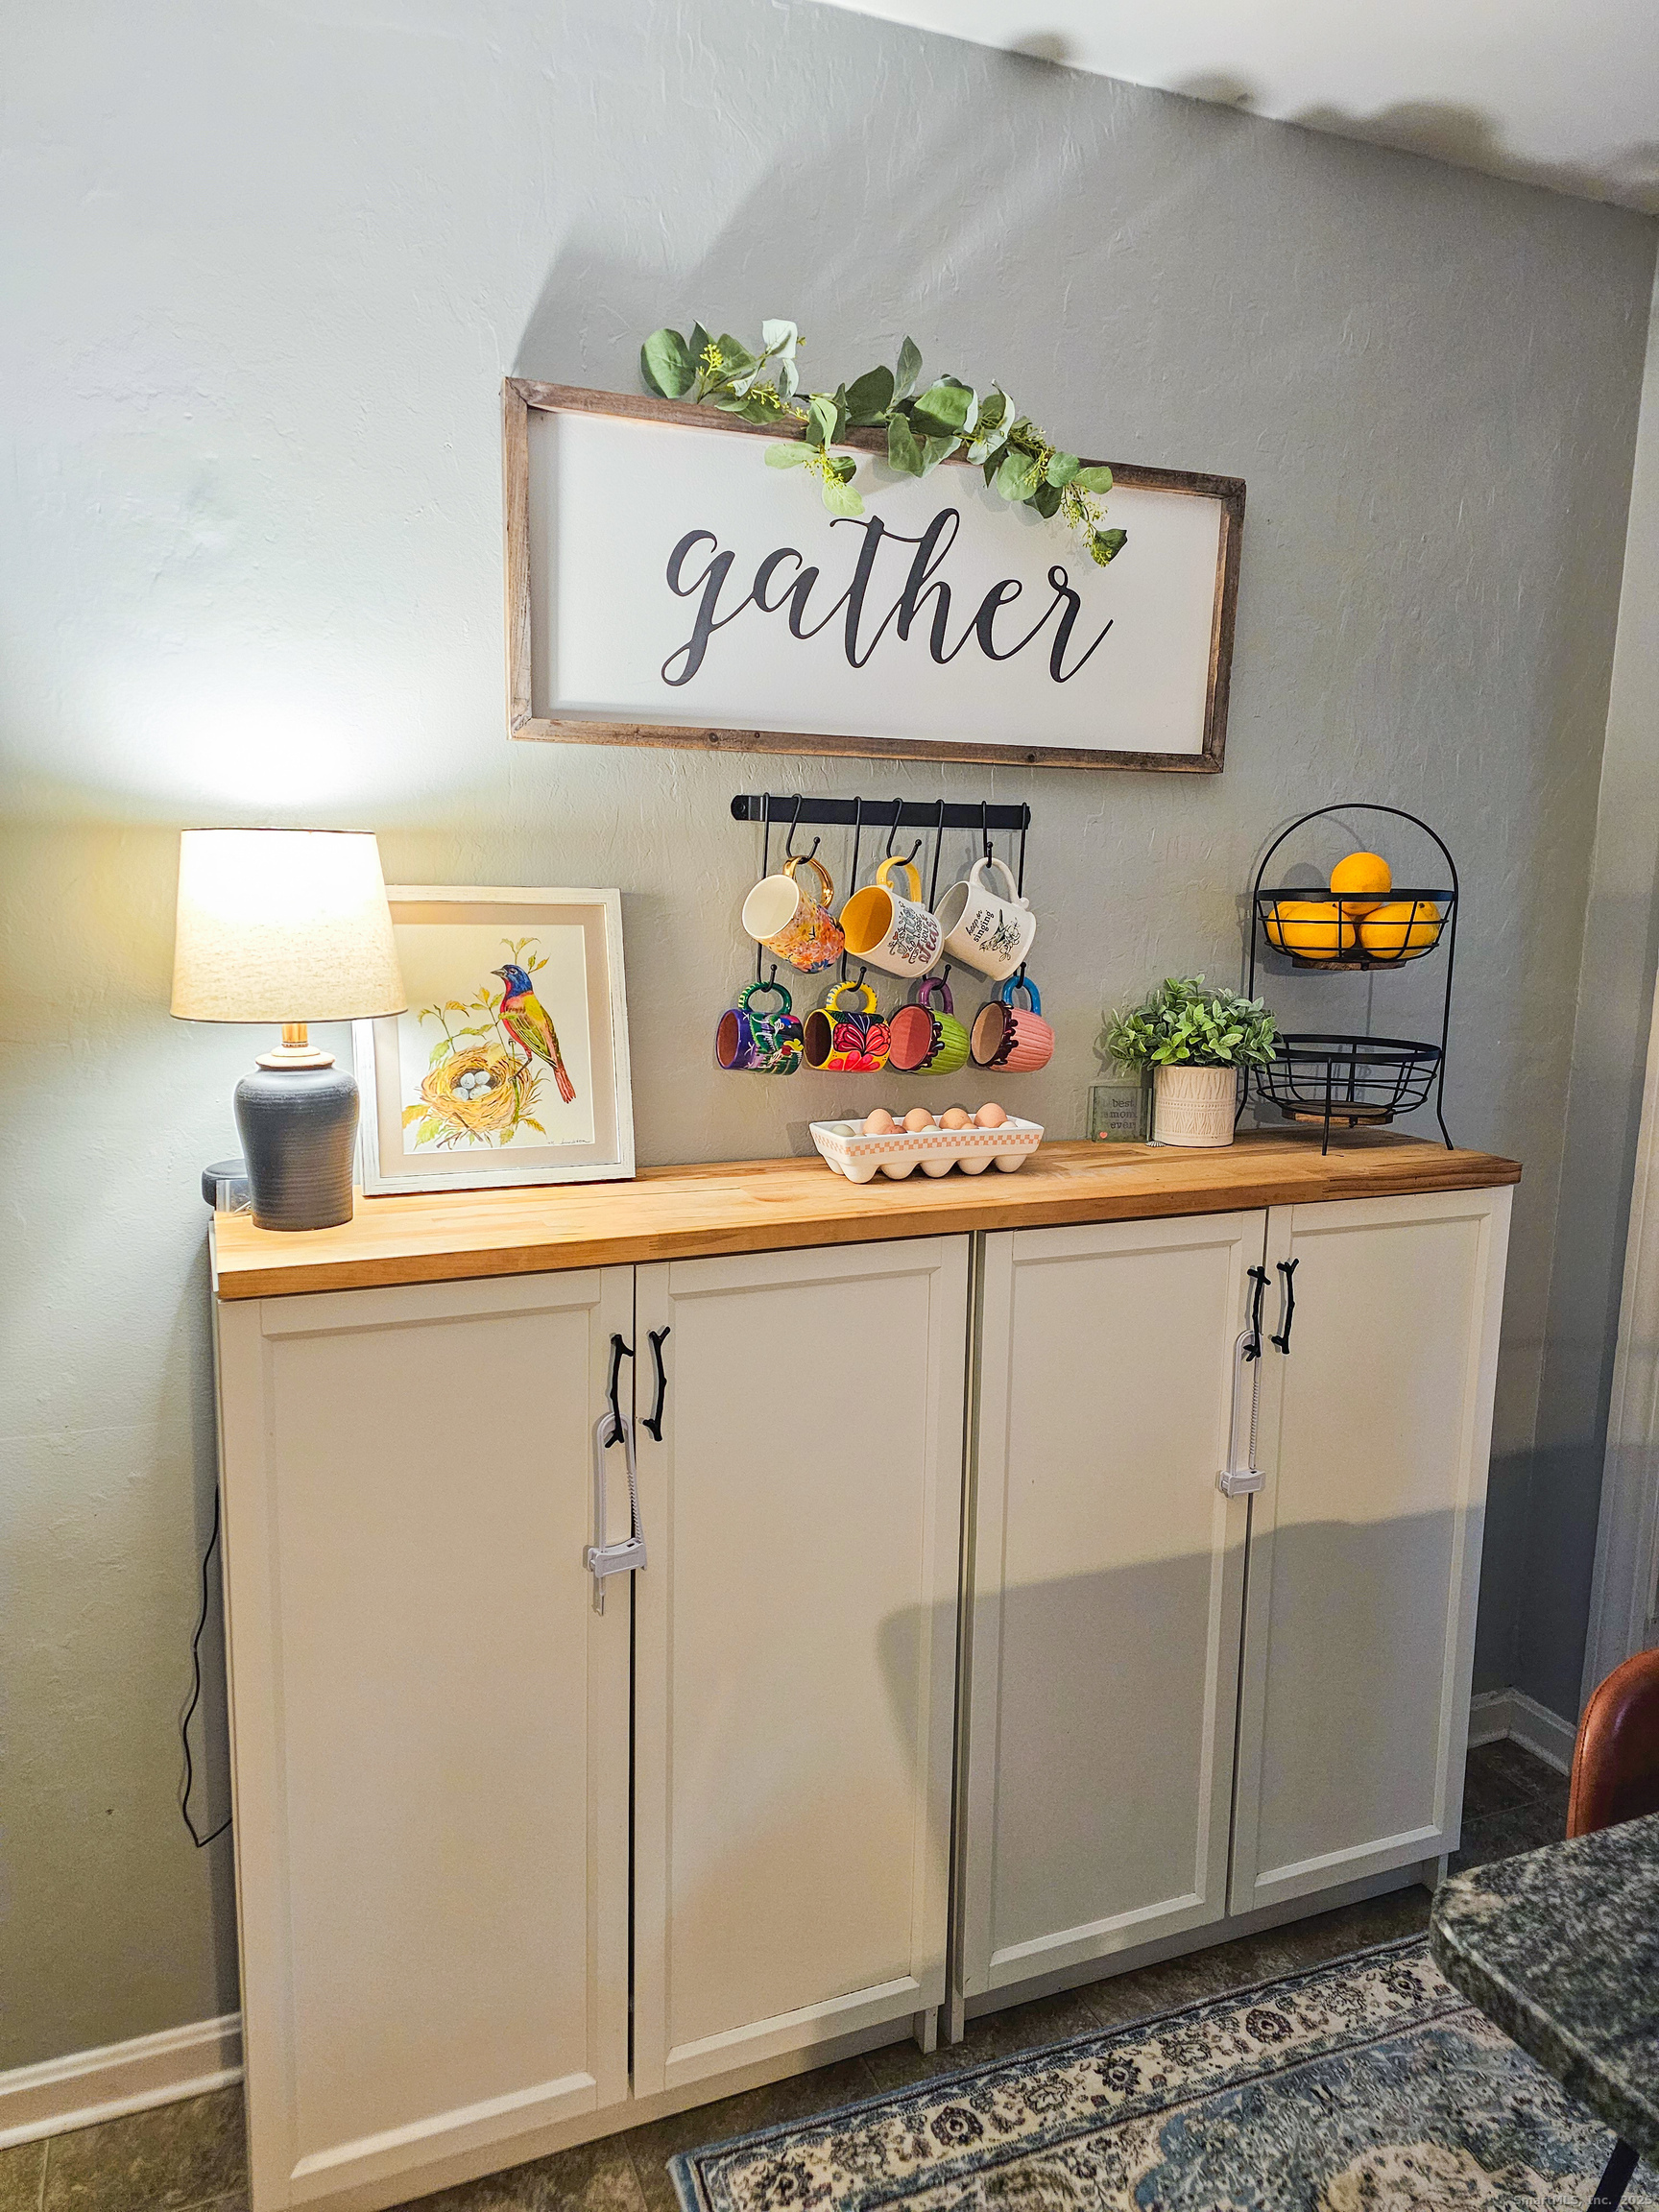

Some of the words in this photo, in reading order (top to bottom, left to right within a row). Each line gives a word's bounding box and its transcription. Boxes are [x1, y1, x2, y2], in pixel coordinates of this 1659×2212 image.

[661, 507, 1114, 687] gather
[965, 918, 979, 936] keep
[973, 909, 995, 943] singing
[1112, 1098, 1135, 1108] best
